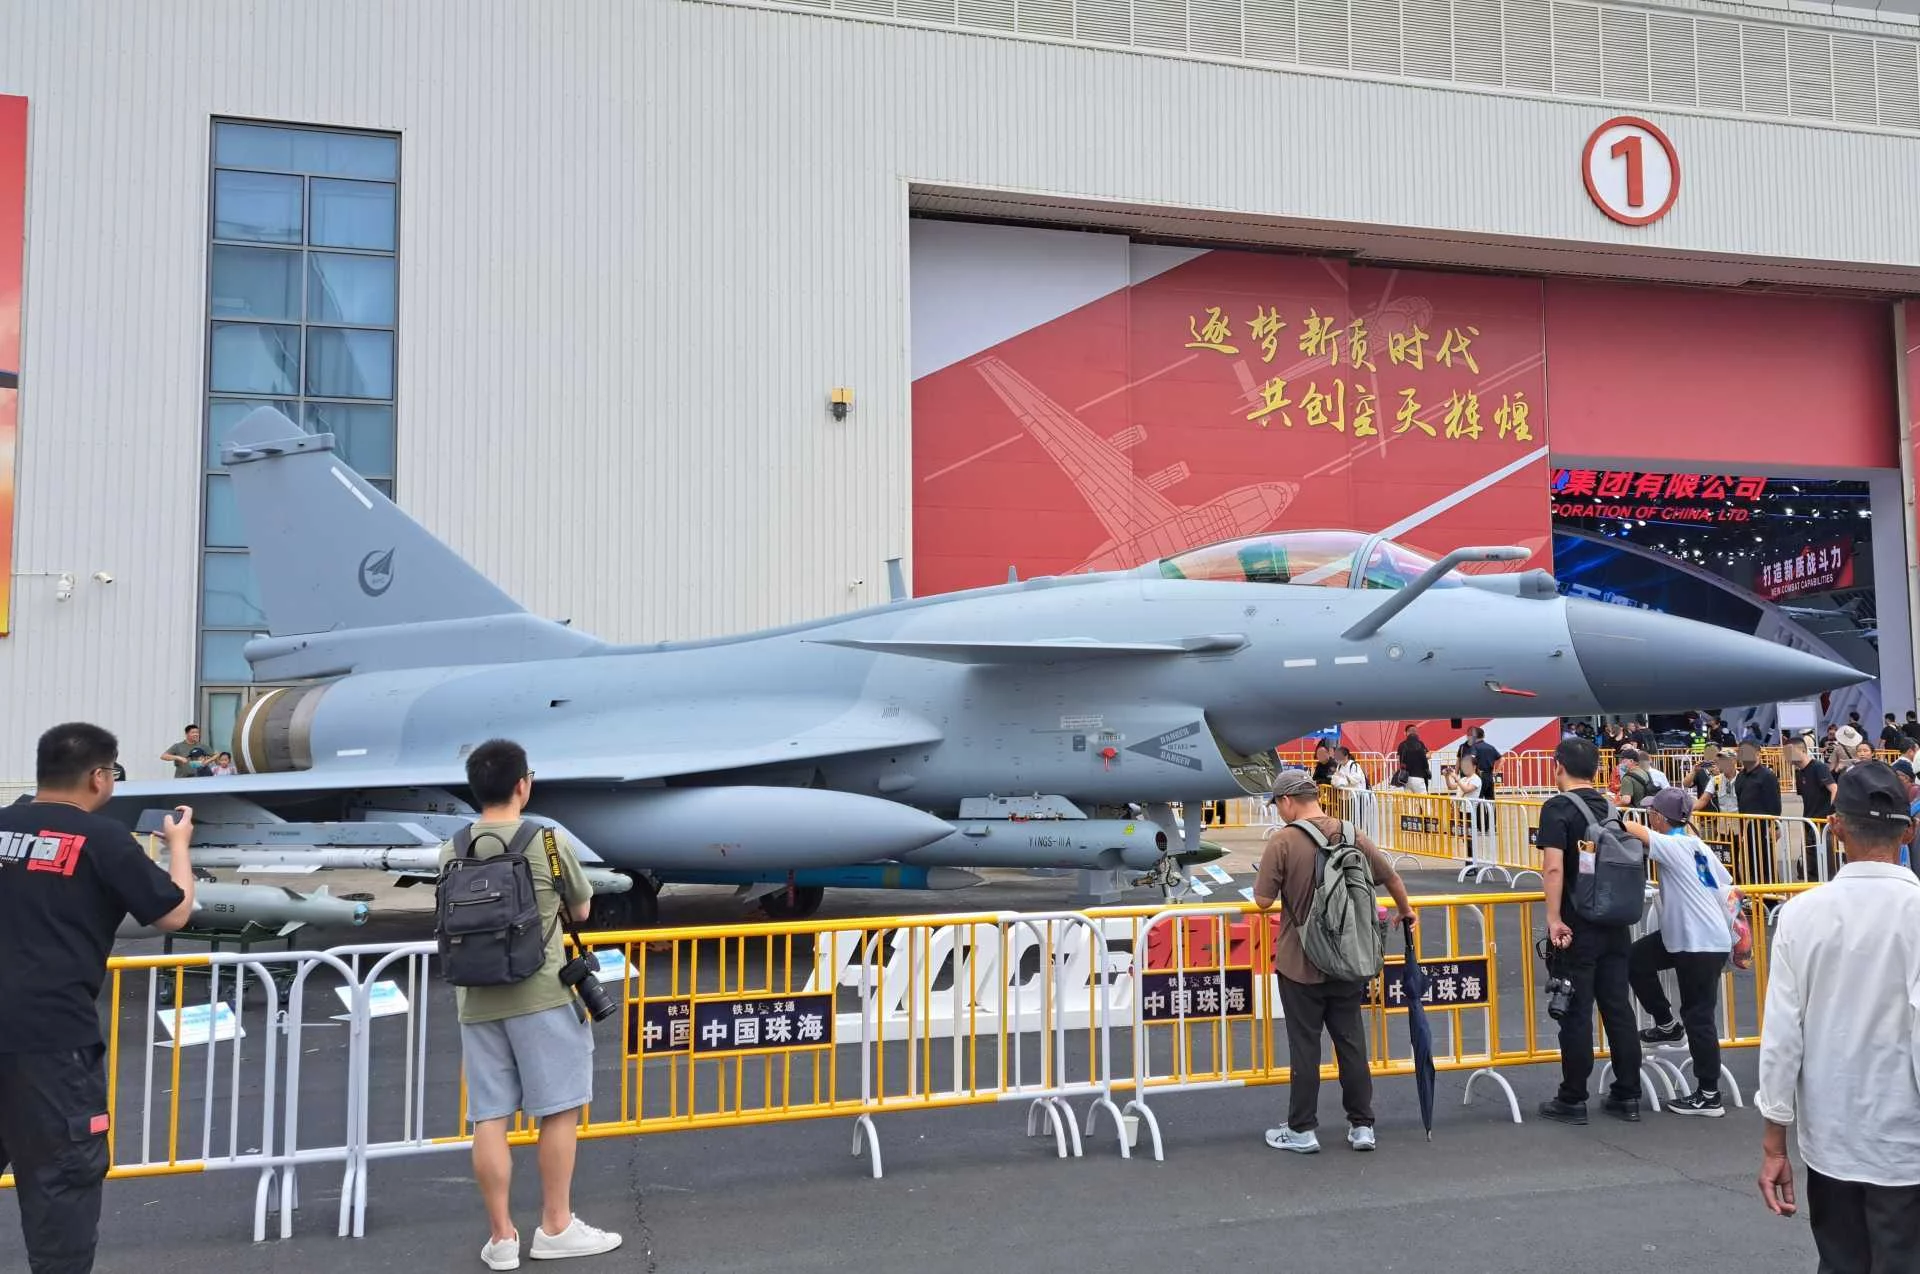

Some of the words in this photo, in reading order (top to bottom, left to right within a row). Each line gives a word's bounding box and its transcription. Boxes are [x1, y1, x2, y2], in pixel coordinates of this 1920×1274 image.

[1611, 136, 1644, 206] 1
[1637, 506, 1657, 519] OF
[1781, 582, 1800, 594] COMBAT
[1801, 574, 1834, 589] CAPABILITIES
[732, 1003, 754, 1015] 铁马
[773, 1001, 795, 1013] 交通
[1144, 986, 1246, 1016] 中国珠海
[702, 1013, 824, 1048] 中国珠海
